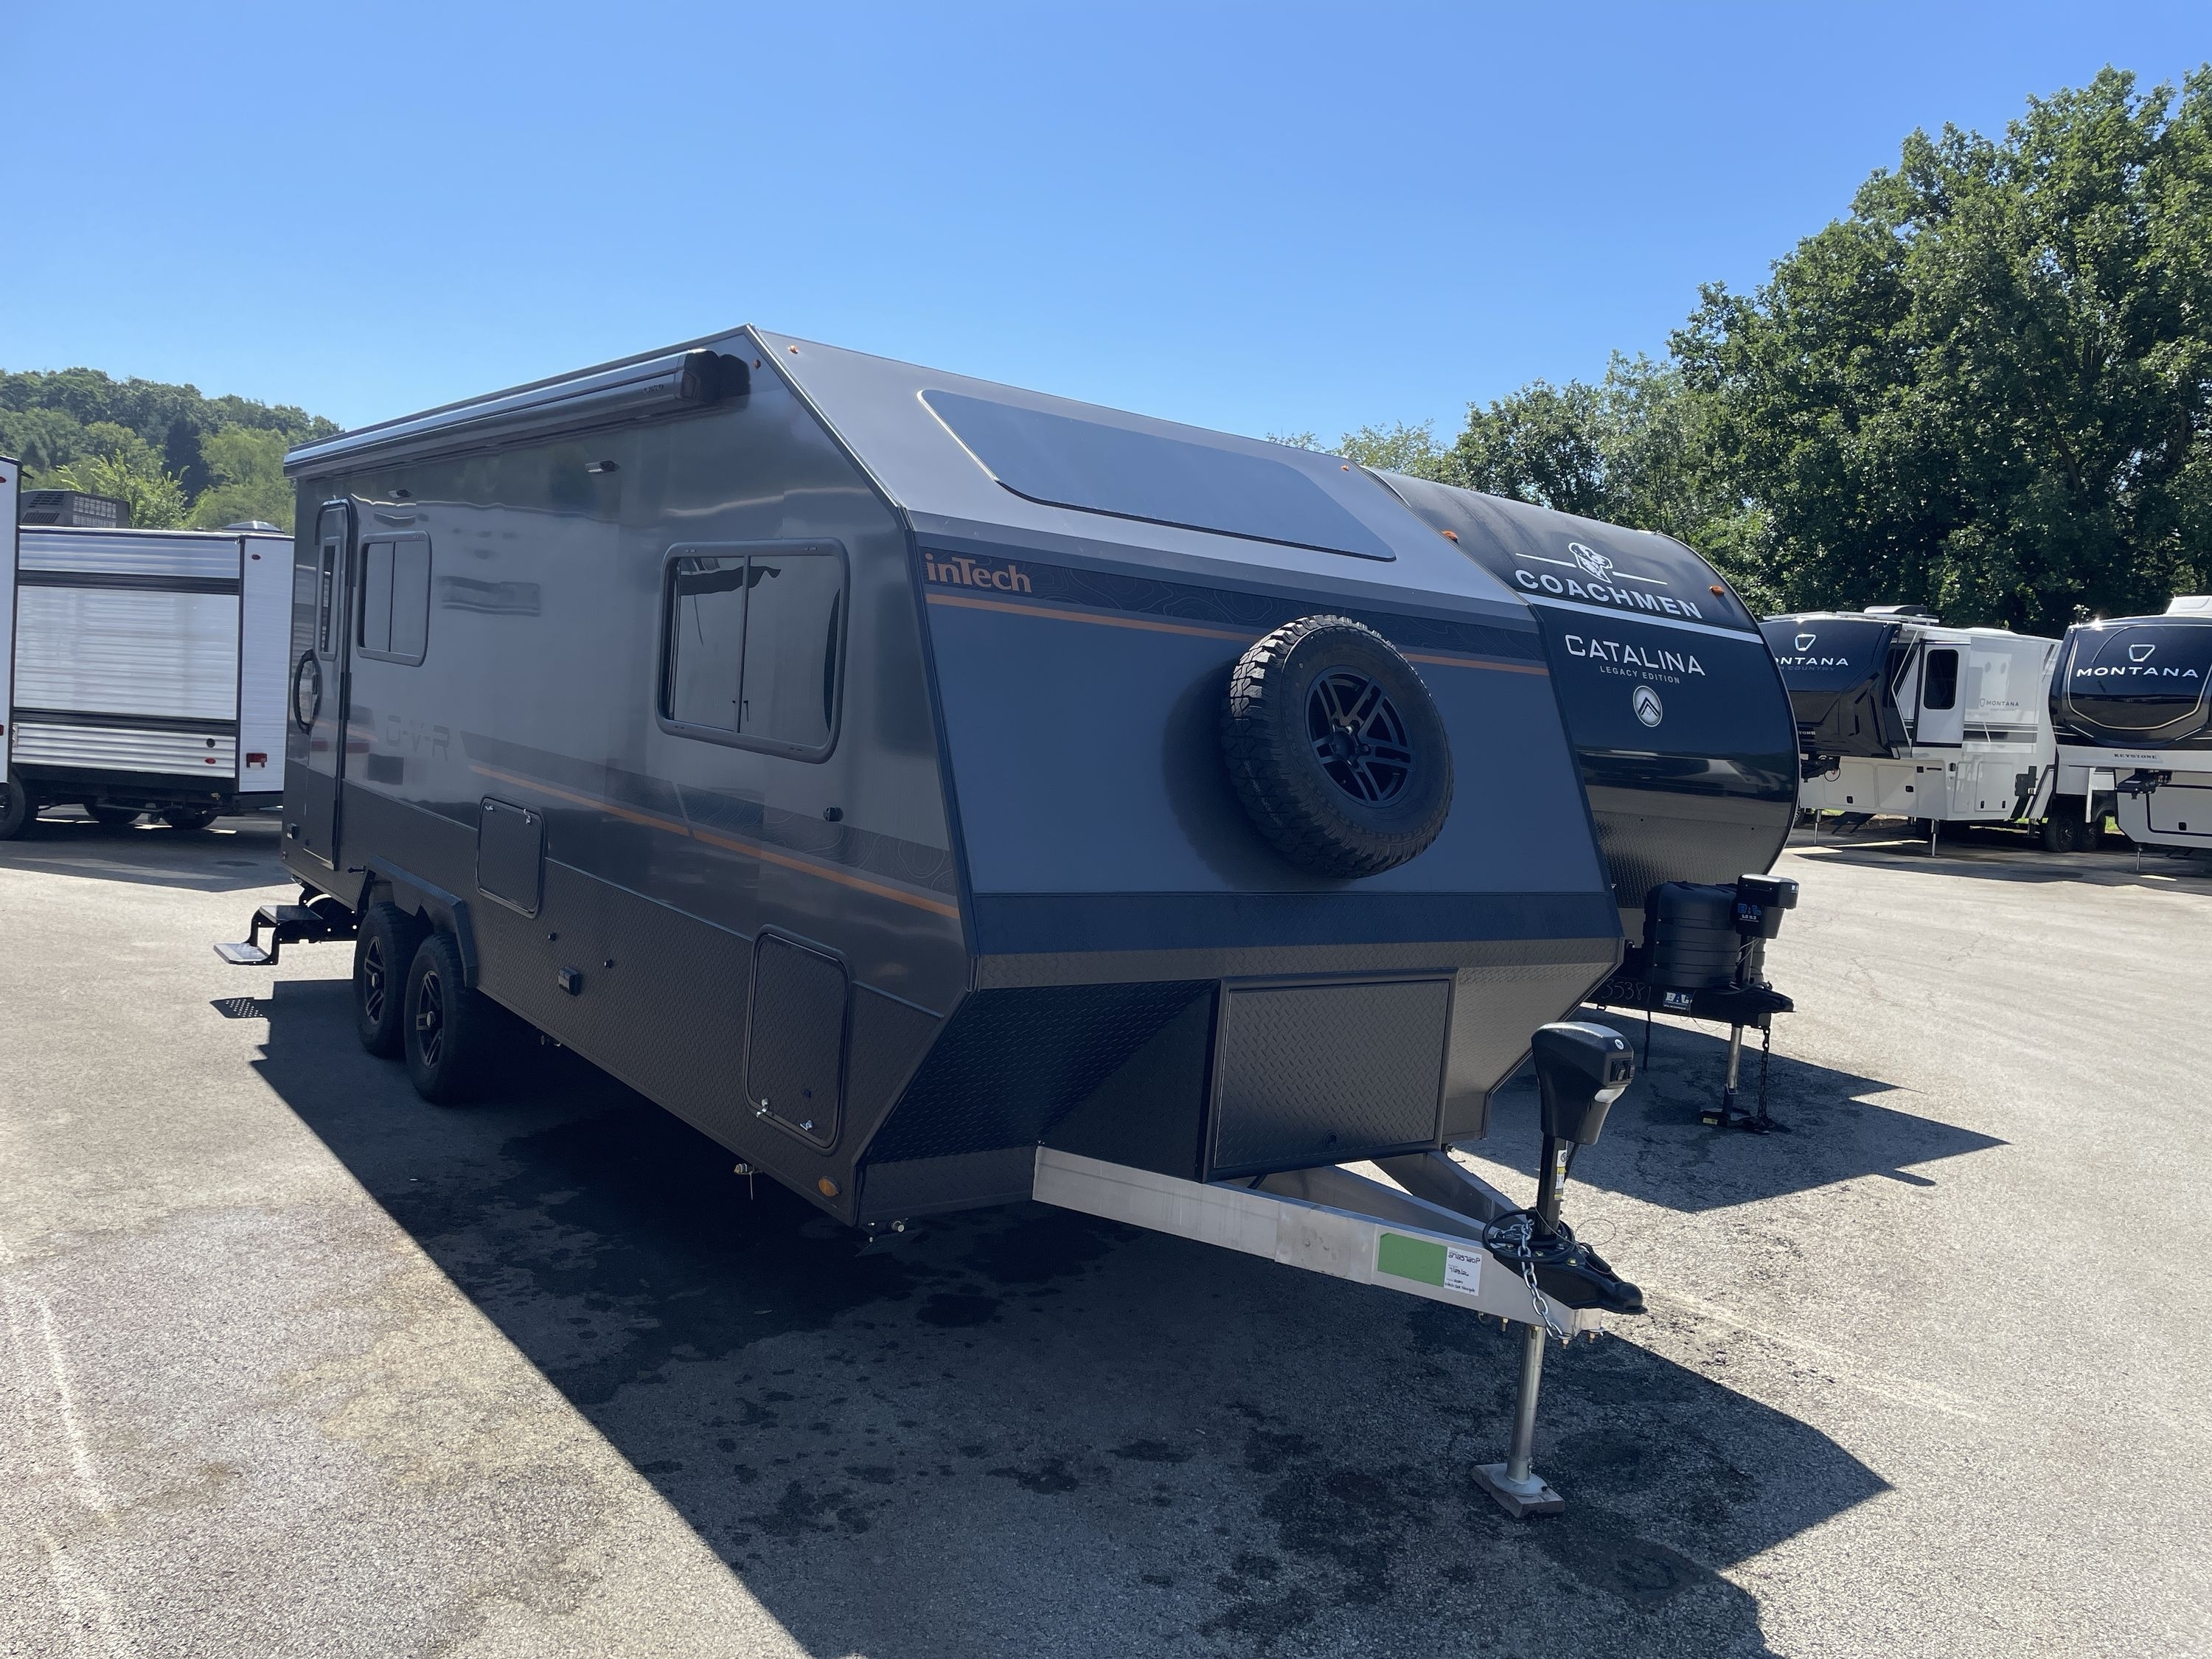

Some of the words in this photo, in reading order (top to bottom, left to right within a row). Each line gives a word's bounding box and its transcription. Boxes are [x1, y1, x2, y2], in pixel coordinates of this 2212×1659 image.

[925, 553, 1032, 593] inTech
[1514, 569, 1703, 619] COACHMEN
[1565, 634, 1706, 676] CATALINA
[1599, 665, 1638, 678] LEGACY
[1642, 672, 1680, 684] EDITION
[2076, 667, 2199, 678] MONTANA
